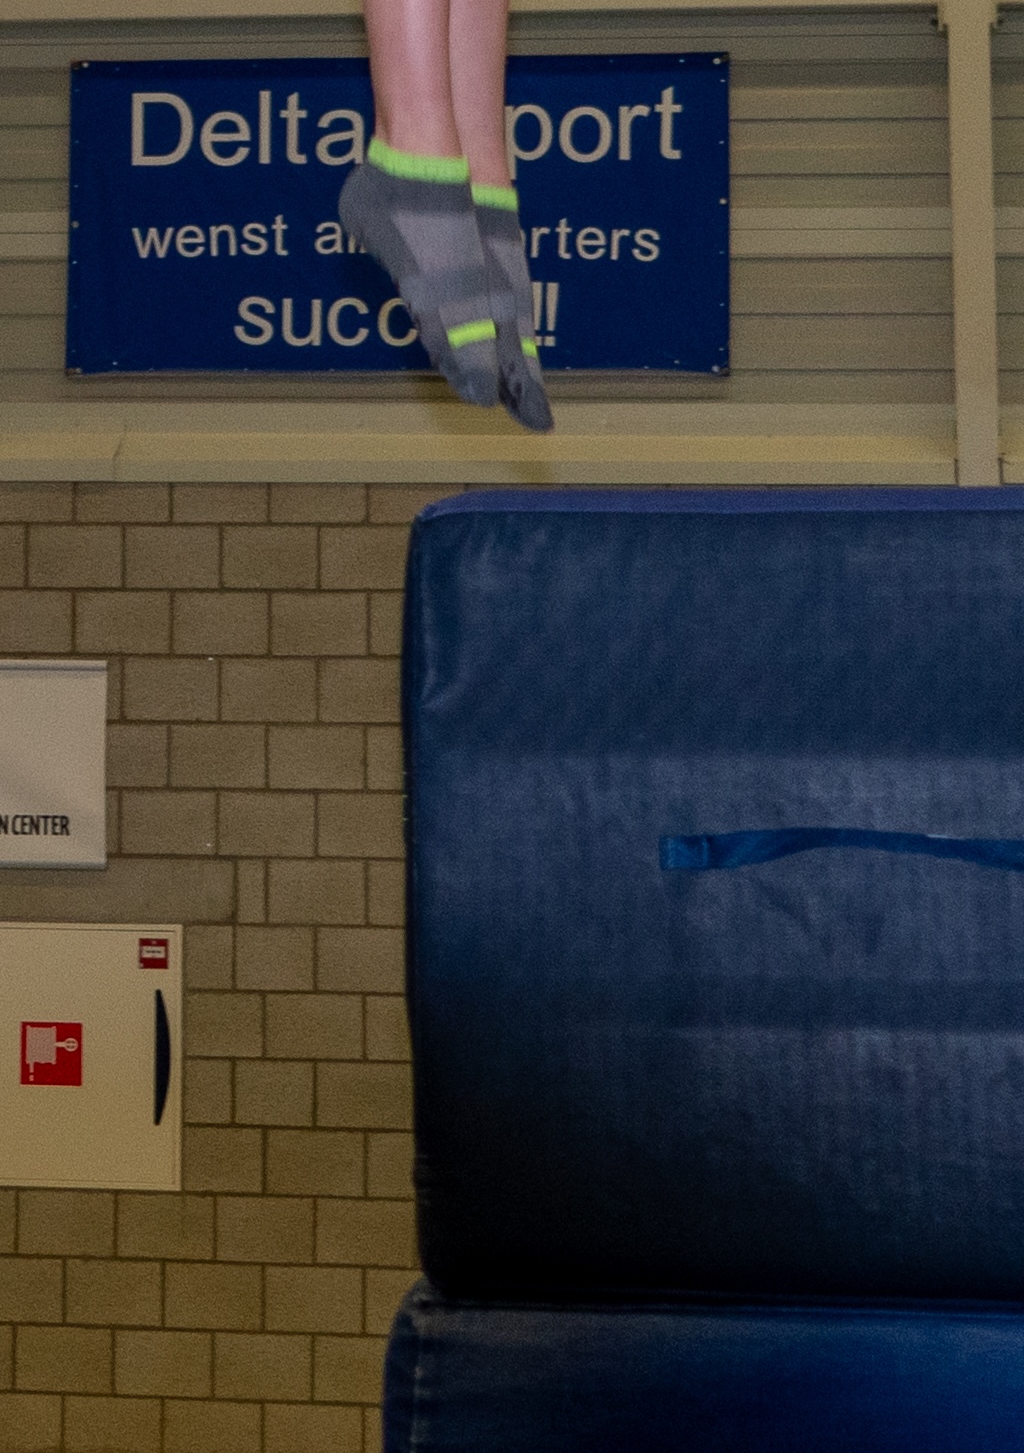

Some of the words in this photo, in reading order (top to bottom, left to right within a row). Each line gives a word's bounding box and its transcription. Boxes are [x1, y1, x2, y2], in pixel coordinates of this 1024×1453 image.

[131, 90, 365, 166] Delta
[504, 87, 682, 181] port
[132, 215, 288, 259] wenst
[520, 218, 661, 262] rters
[234, 282, 559, 347] succ!!
[12, 814, 70, 836] CENTER
